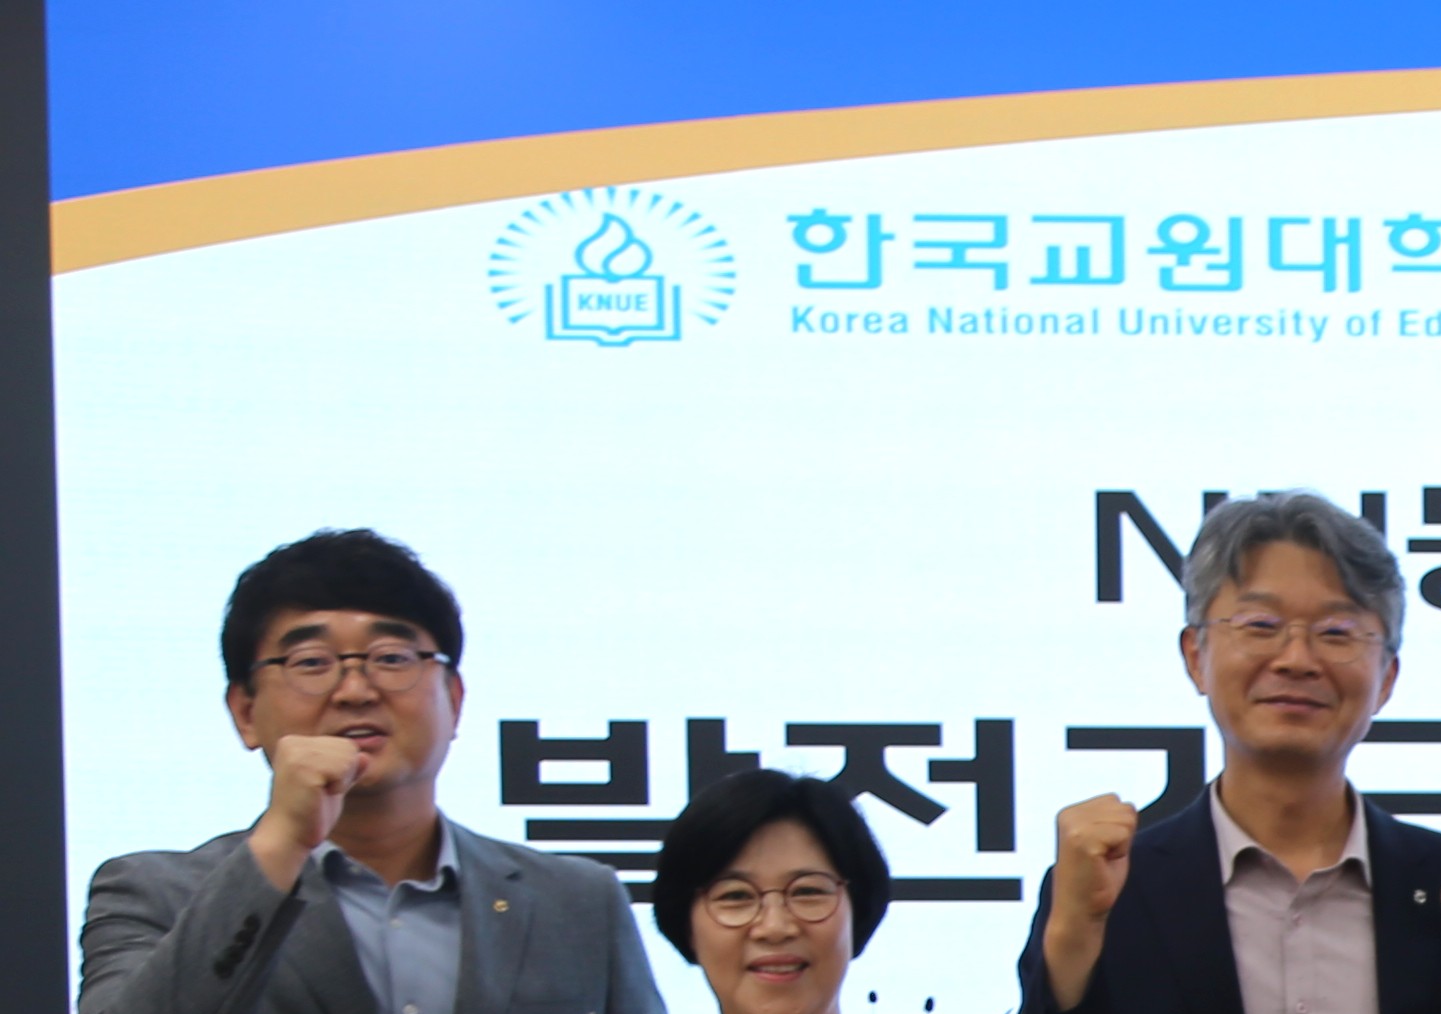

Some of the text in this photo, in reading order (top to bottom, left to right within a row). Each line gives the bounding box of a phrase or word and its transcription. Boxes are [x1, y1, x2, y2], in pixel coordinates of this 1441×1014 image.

[577, 292, 649, 312] KNUE
[791, 305, 909, 338] Korea
[928, 305, 1099, 338] National
[1118, 305, 1329, 343] University
[1345, 305, 1381, 338] of
